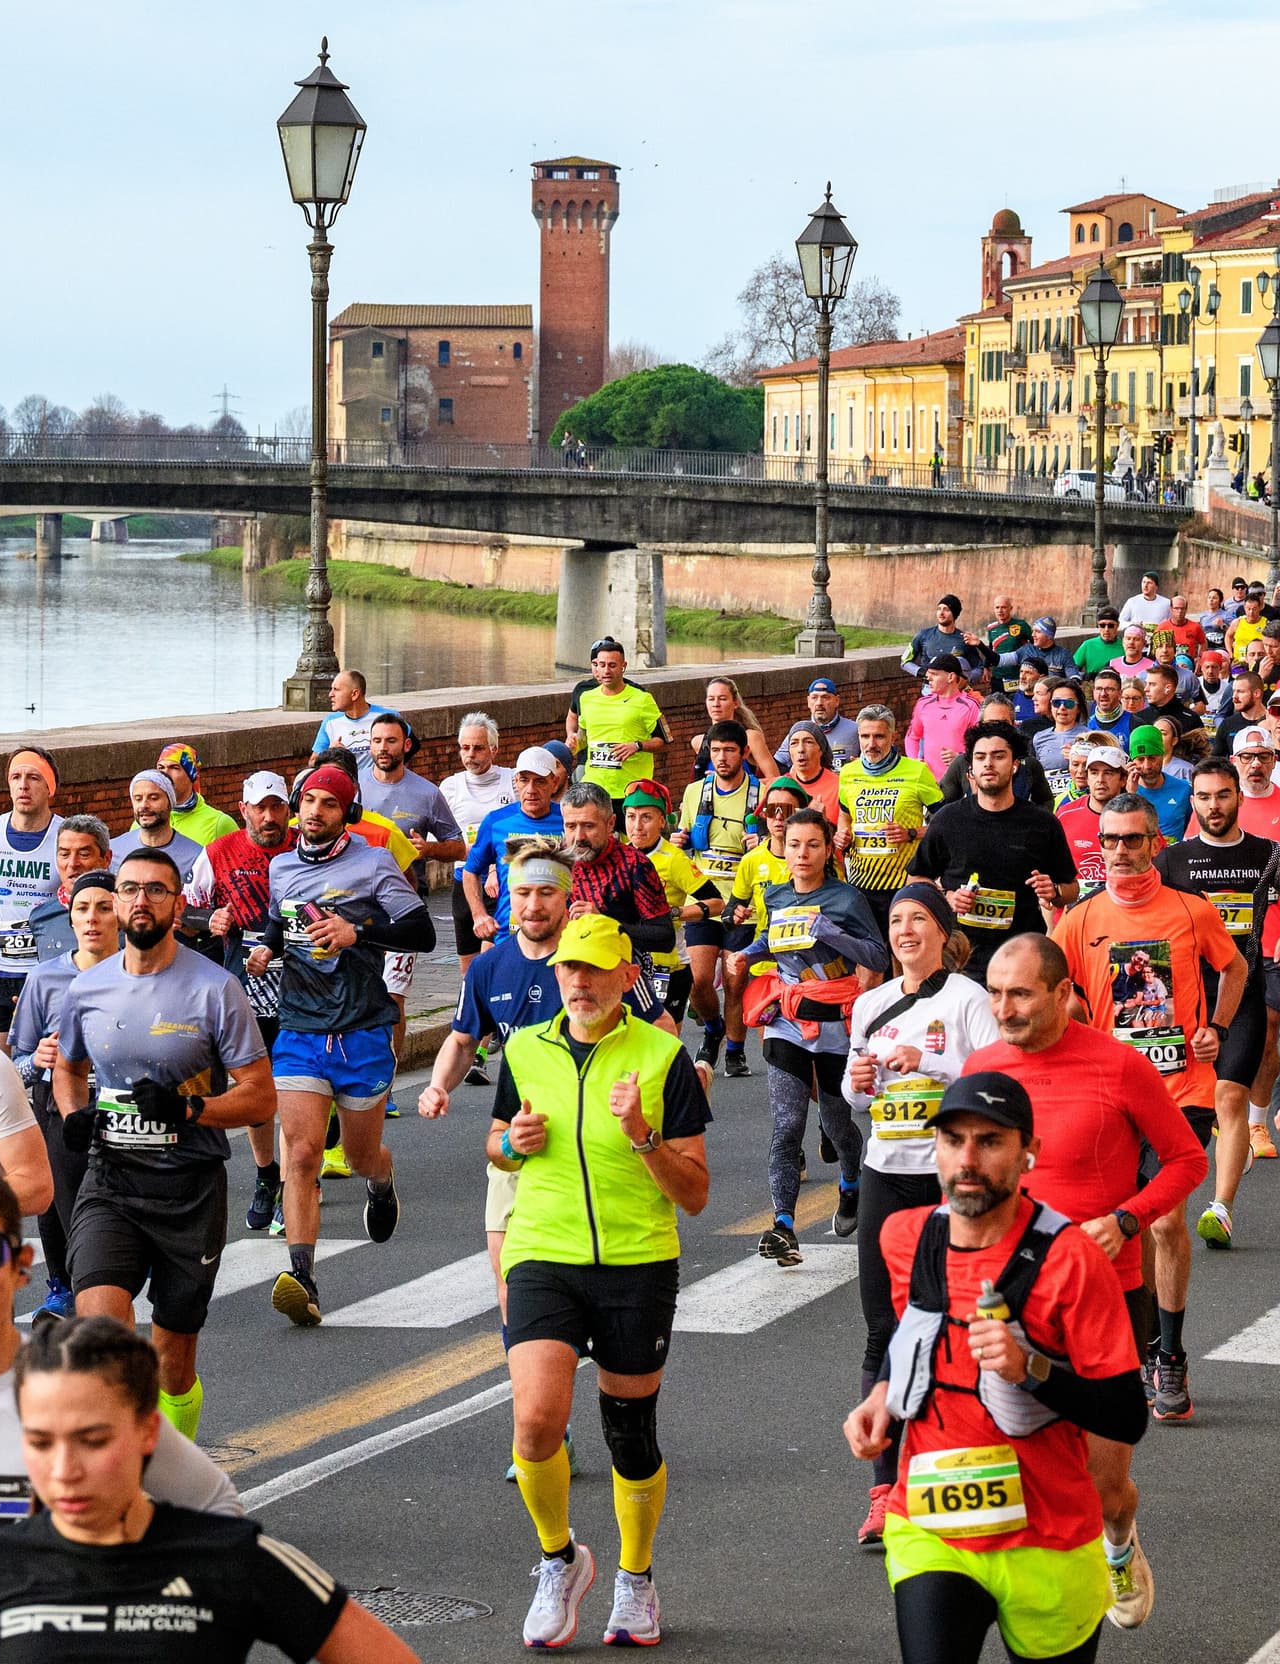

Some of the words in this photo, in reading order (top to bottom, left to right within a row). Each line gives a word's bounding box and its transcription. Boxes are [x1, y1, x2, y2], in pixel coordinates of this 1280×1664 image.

[859, 788, 898, 798] Atletica
[855, 798, 896, 809] Campi
[854, 808, 893, 824] RUN
[861, 836, 888, 849] 733
[708, 859, 731, 872] 742
[1189, 869, 1260, 881] PARMARATHON
[780, 923, 808, 938] 771
[5, 934, 33, 949] 267
[392, 954, 415, 974] 18
[882, 1101, 929, 1121] 912
[921, 1480, 1008, 1515] 1695
[114, 1604, 213, 1622] STOCKHOLM
[114, 1619, 151, 1632] RUN
[153, 1619, 197, 1633] CLUB
